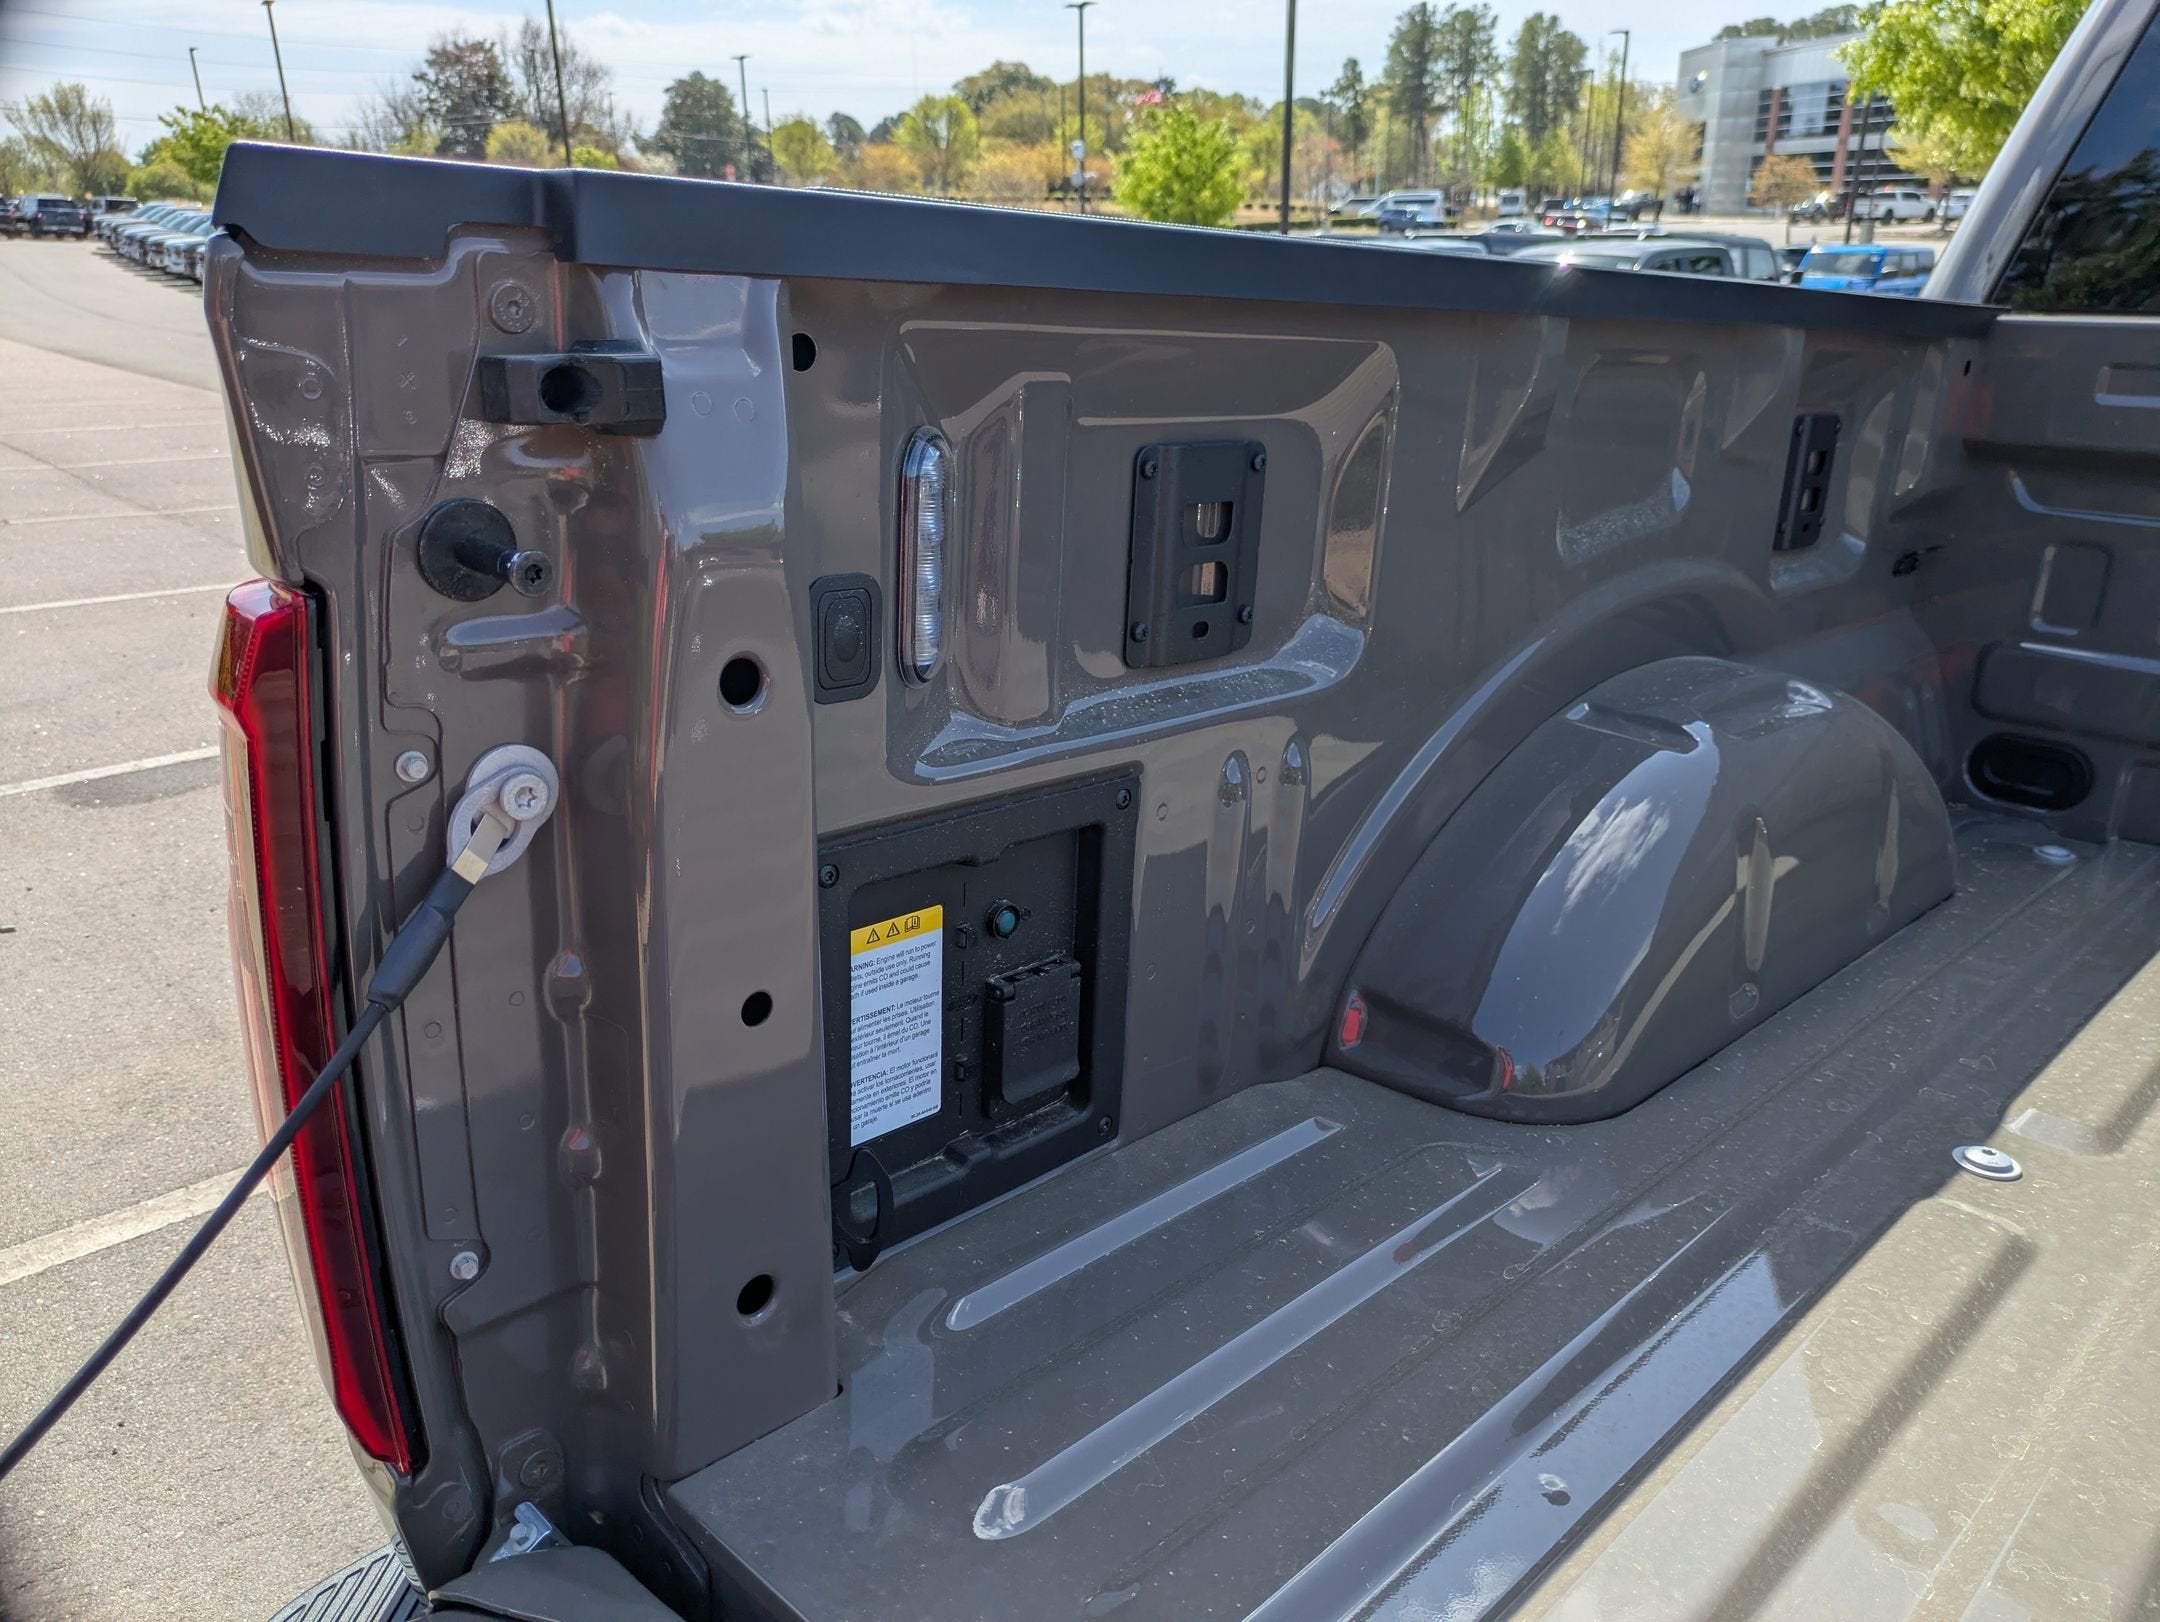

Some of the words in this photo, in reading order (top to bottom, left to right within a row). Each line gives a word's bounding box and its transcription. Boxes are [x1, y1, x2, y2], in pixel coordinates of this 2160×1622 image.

[877, 955, 895, 964] Engine
[921, 941, 936, 952] power
[865, 966, 884, 977] outside
[909, 952, 930, 962] Running
[864, 977, 878, 986] emits
[900, 965, 914, 975] could
[915, 960, 930, 969] cause
[865, 986, 878, 995] used
[879, 980, 894, 990] inside
[904, 997, 922, 1006] moteur
[924, 991, 939, 1000] tourne
[858, 1020, 881, 1032] alimenter
[910, 1001, 934, 1013] Utilisation
[905, 1014, 923, 1024] Quand
[912, 1028, 930, 1040] garage
[896, 1062, 911, 1070] motor
[915, 1072, 929, 1080] motor
[858, 1084, 875, 1094] activar
[870, 1104, 888, 1114] muerte
[913, 1087, 931, 1098] adentro
